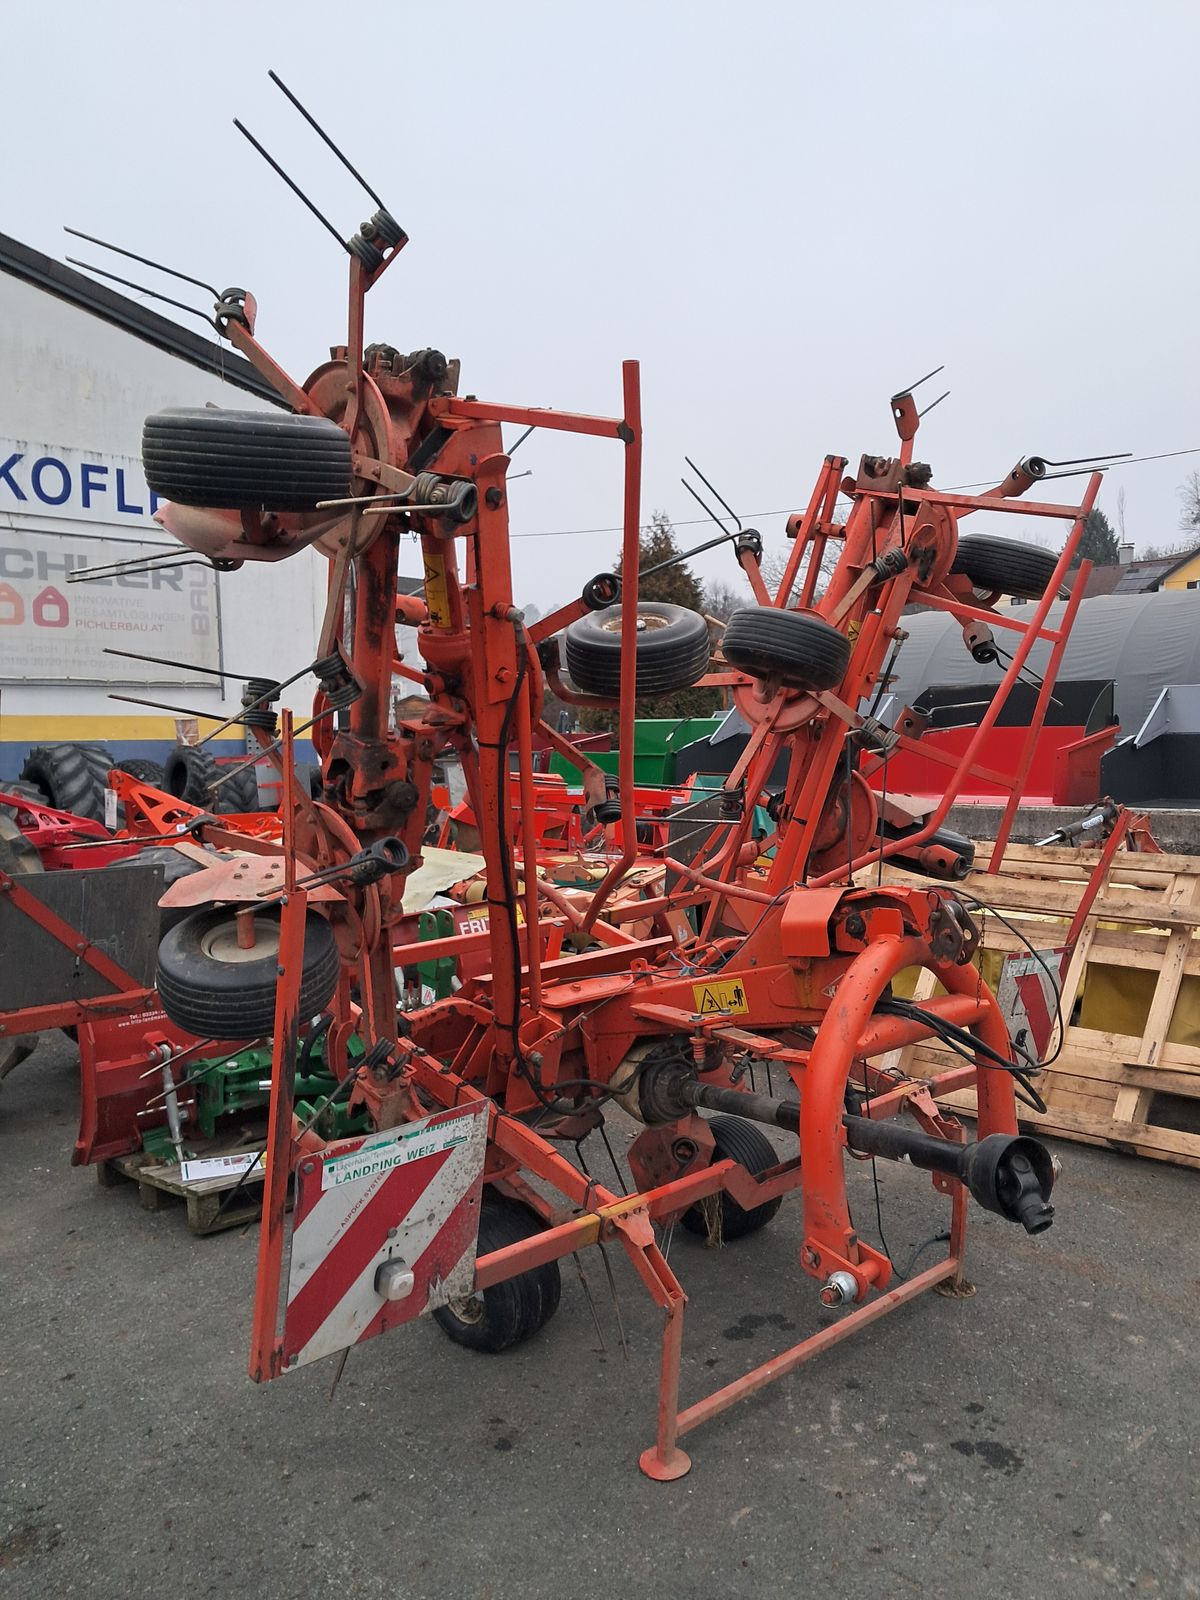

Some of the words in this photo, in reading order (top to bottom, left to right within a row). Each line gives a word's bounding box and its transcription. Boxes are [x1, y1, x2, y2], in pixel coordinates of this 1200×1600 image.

[0, 452, 168, 516] KOFL
[74, 594, 145, 608] INNOVATIVE
[75, 619, 165, 633] PICHLERBAU.AT
[459, 917, 490, 935] FRI
